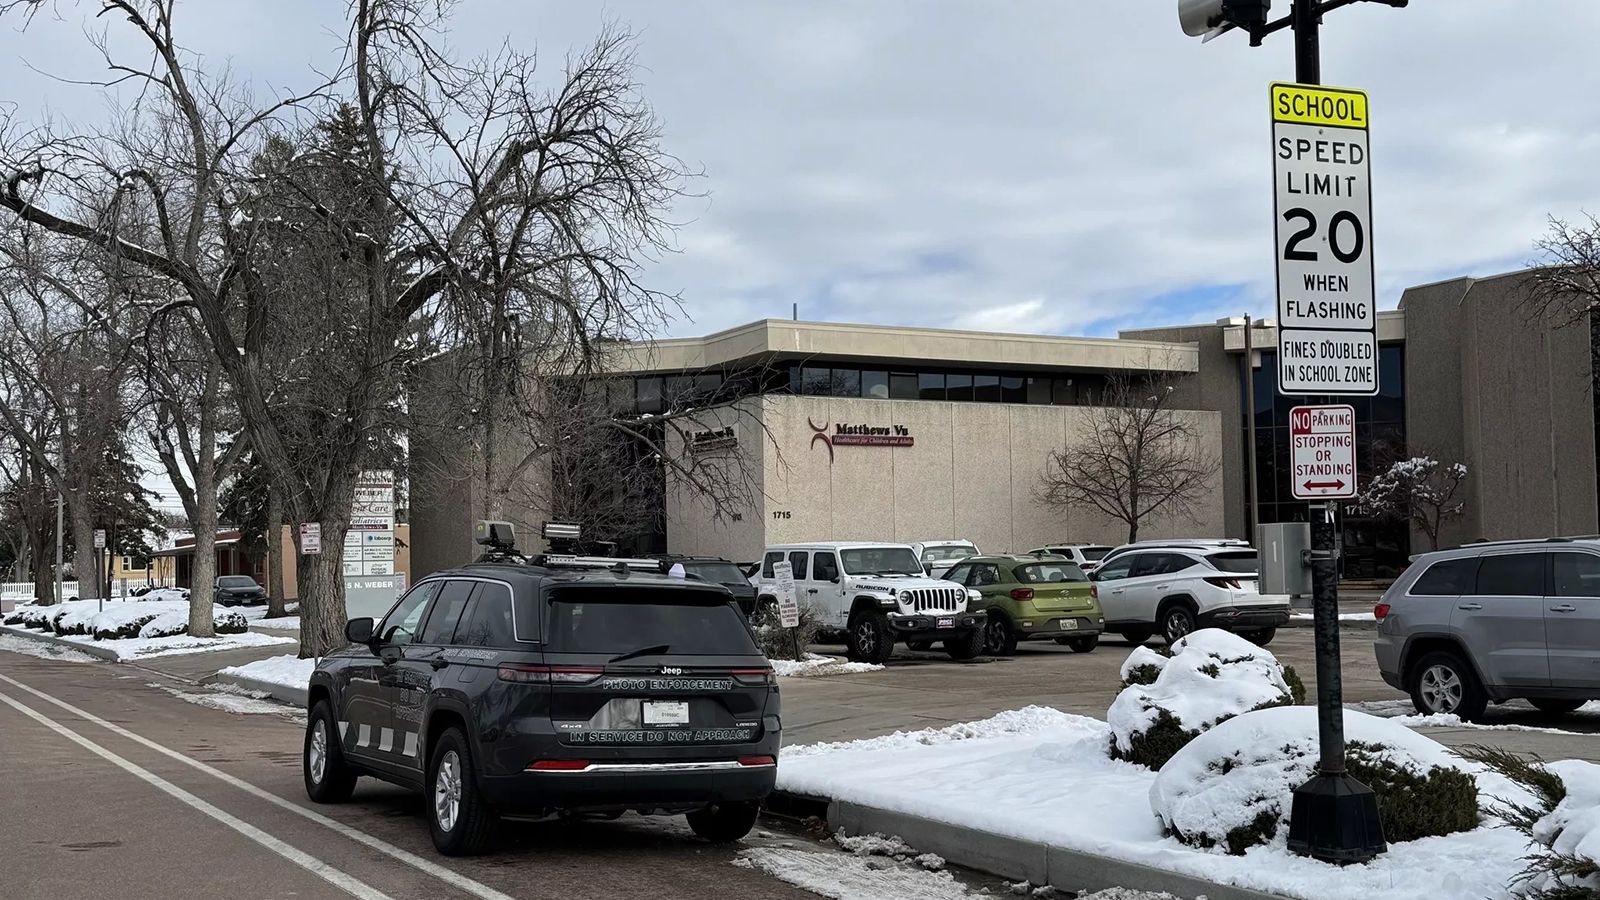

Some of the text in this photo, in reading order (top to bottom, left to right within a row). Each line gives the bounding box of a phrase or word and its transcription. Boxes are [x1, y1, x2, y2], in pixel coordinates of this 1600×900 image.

[1278, 92, 1362, 122] SCHOOL
[1278, 137, 1364, 165] SPEED
[1287, 171, 1356, 197] LIMIT
[1282, 207, 1364, 263] 20
[1303, 273, 1348, 292] WHEN
[1286, 300, 1366, 320] FLASHING
[1284, 341, 1371, 360] FINES DOUBLED
[1284, 364, 1372, 383] IN SCHOOL ZONE
[1293, 412, 1351, 430] NO PARKING
[836, 423, 890, 436] Matthews
[1295, 435, 1351, 448] STOPPING
[1315, 450, 1331, 462] OR
[1296, 463, 1352, 476] STANDING
[773, 511, 791, 519] 1715
[365, 580, 393, 588] WEBER
[855, 584, 889, 592] RUBICON
[661, 666, 682, 675] Jeep
[603, 679, 733, 690] PHOTO ENFORCEMENT
[570, 729, 751, 742] IN SERVICE DO NOT APPROACH
